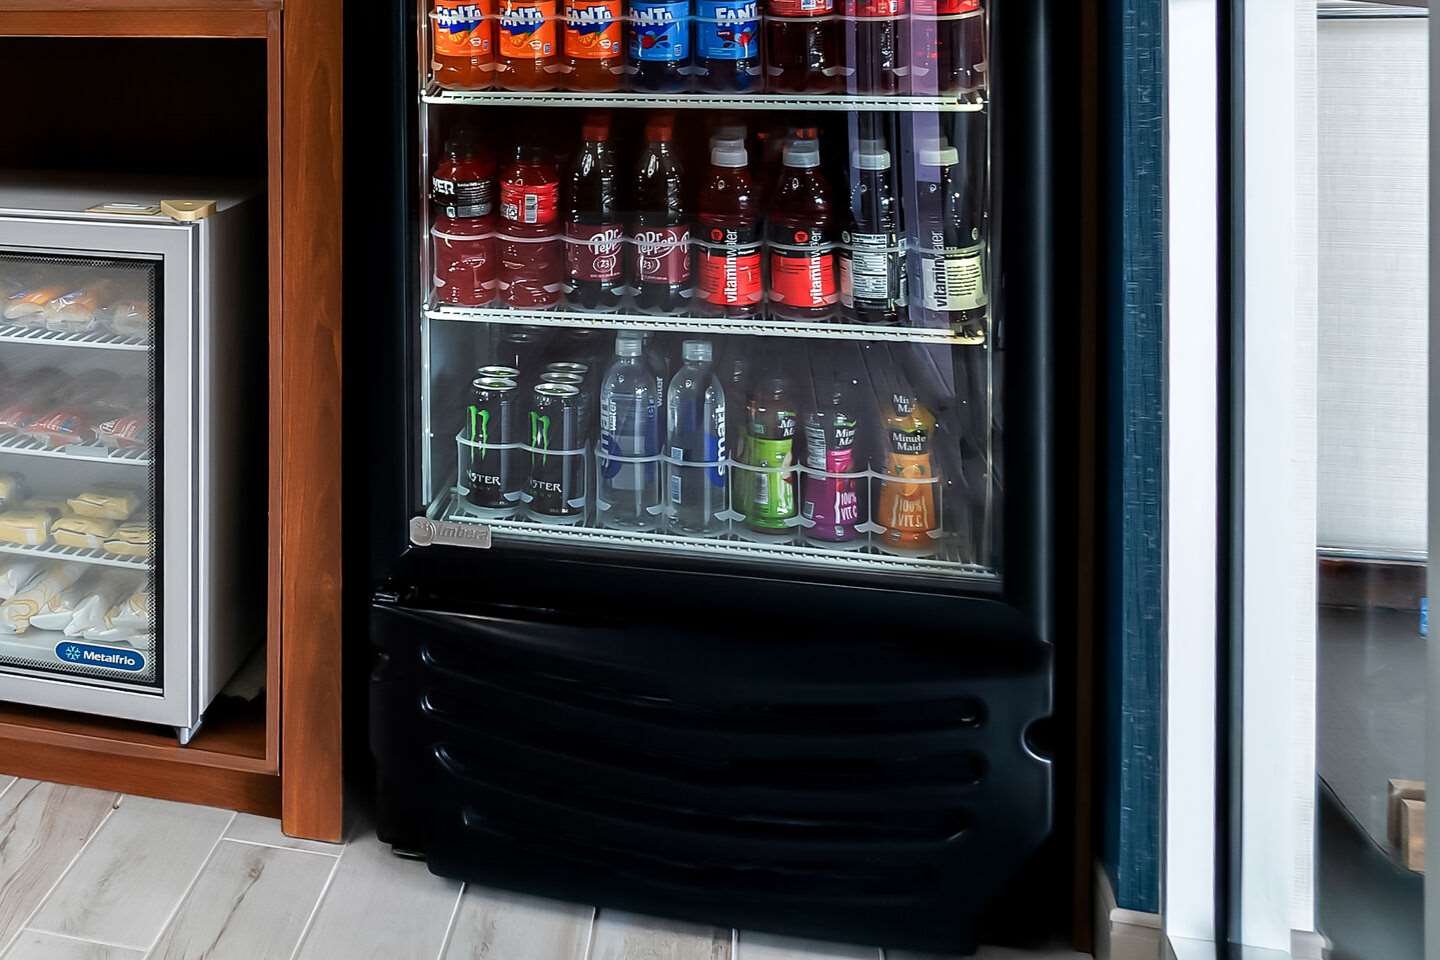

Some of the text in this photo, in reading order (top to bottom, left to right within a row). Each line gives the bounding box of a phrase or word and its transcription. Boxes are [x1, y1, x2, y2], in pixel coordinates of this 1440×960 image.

[436, 4, 481, 26] FANTA
[565, 6, 612, 26] FANTA
[605, 229, 619, 241] Dr
[646, 231, 663, 241] Dr
[599, 259, 609, 268] 23
[724, 229, 738, 303] vitaminwater
[809, 230, 823, 304] vitaminwater
[932, 230, 947, 307] vitaminwater
[715, 404, 726, 476] smart
[892, 432, 926, 442] Minute
[897, 442, 922, 451] Maid
[899, 499, 922, 513] 100%
[83, 650, 136, 666] Metalfrio
